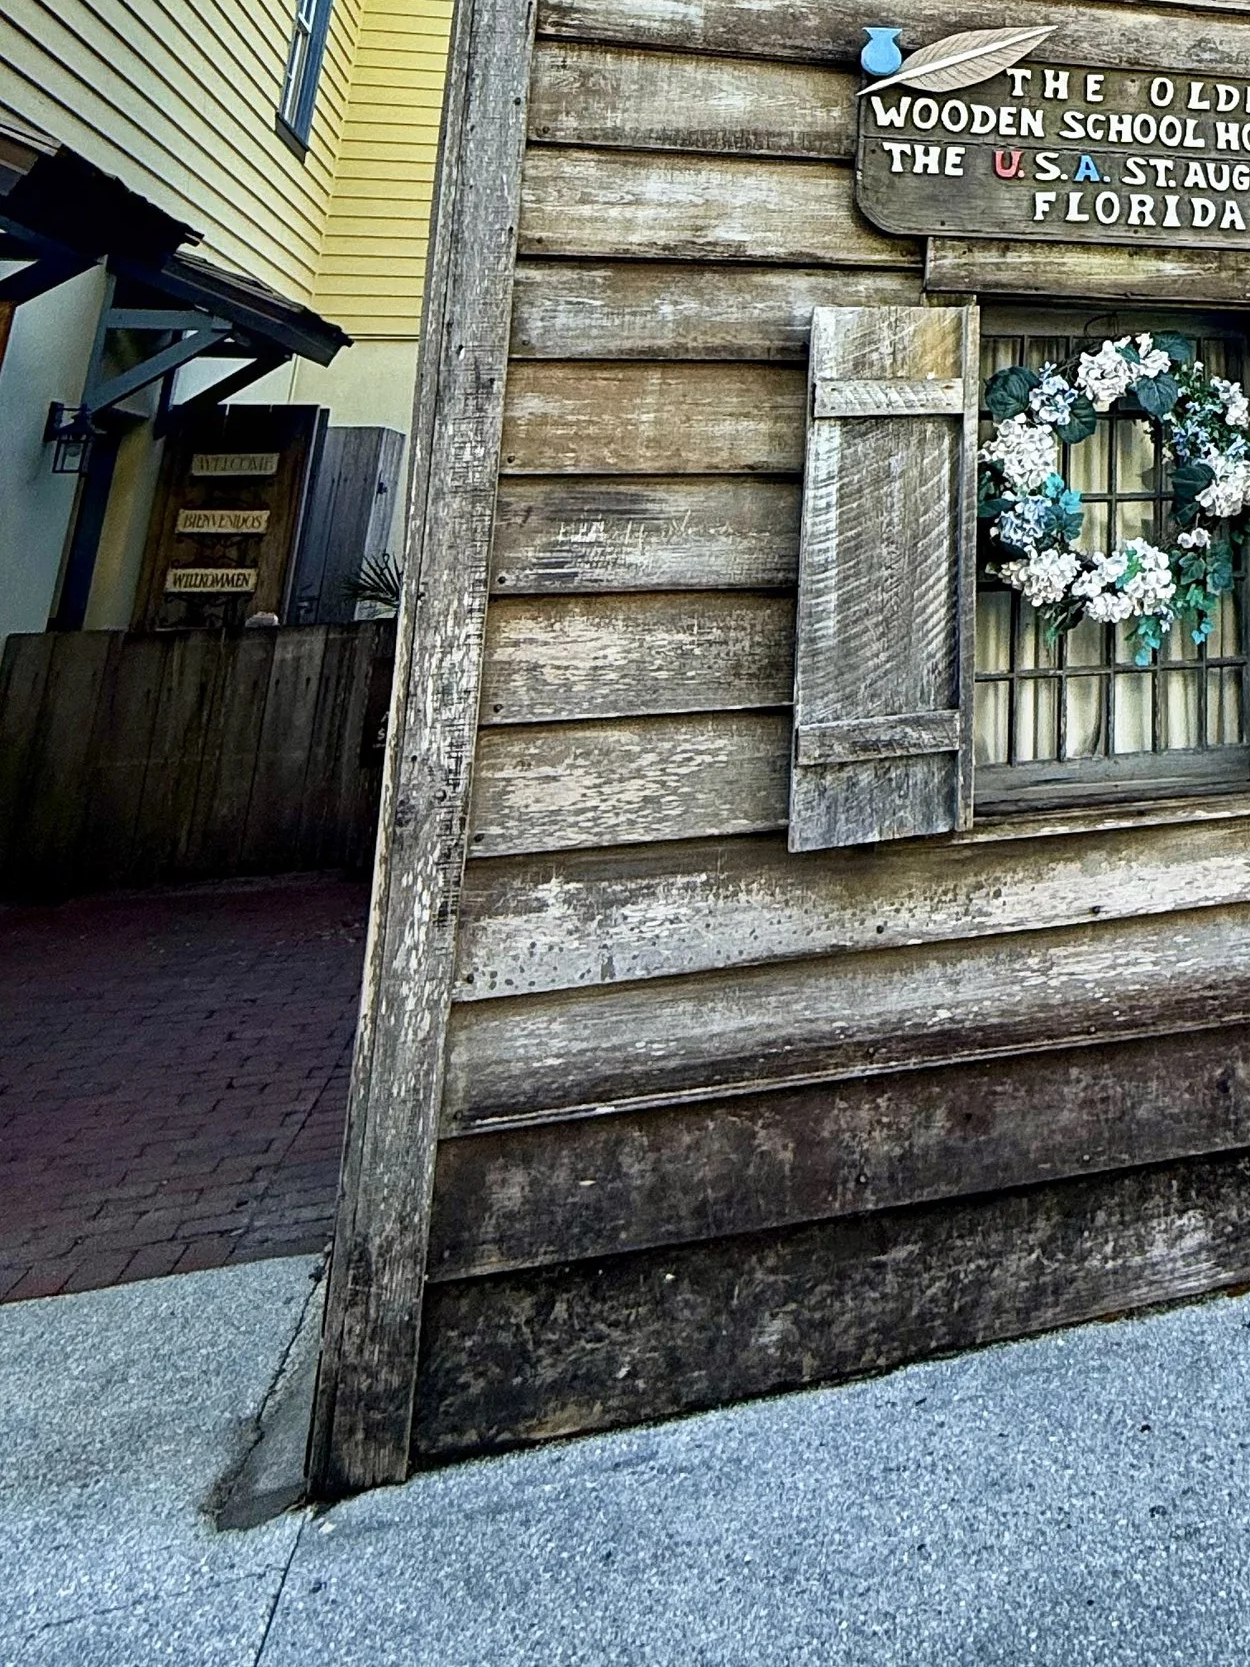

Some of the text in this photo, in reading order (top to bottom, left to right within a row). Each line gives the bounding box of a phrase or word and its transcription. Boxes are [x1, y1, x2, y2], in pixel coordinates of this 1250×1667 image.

[1006, 68, 1105, 102] THE
[870, 96, 1045, 138] WOODEN
[1059, 110, 1206, 149] SCHOOL
[882, 141, 967, 177] THE
[1033, 190, 1247, 230] FLORIDA
[198, 455, 274, 472] WELCOME
[183, 514, 263, 529] BIENVENIDOS
[172, 572, 251, 588] WILLKOMMEN
